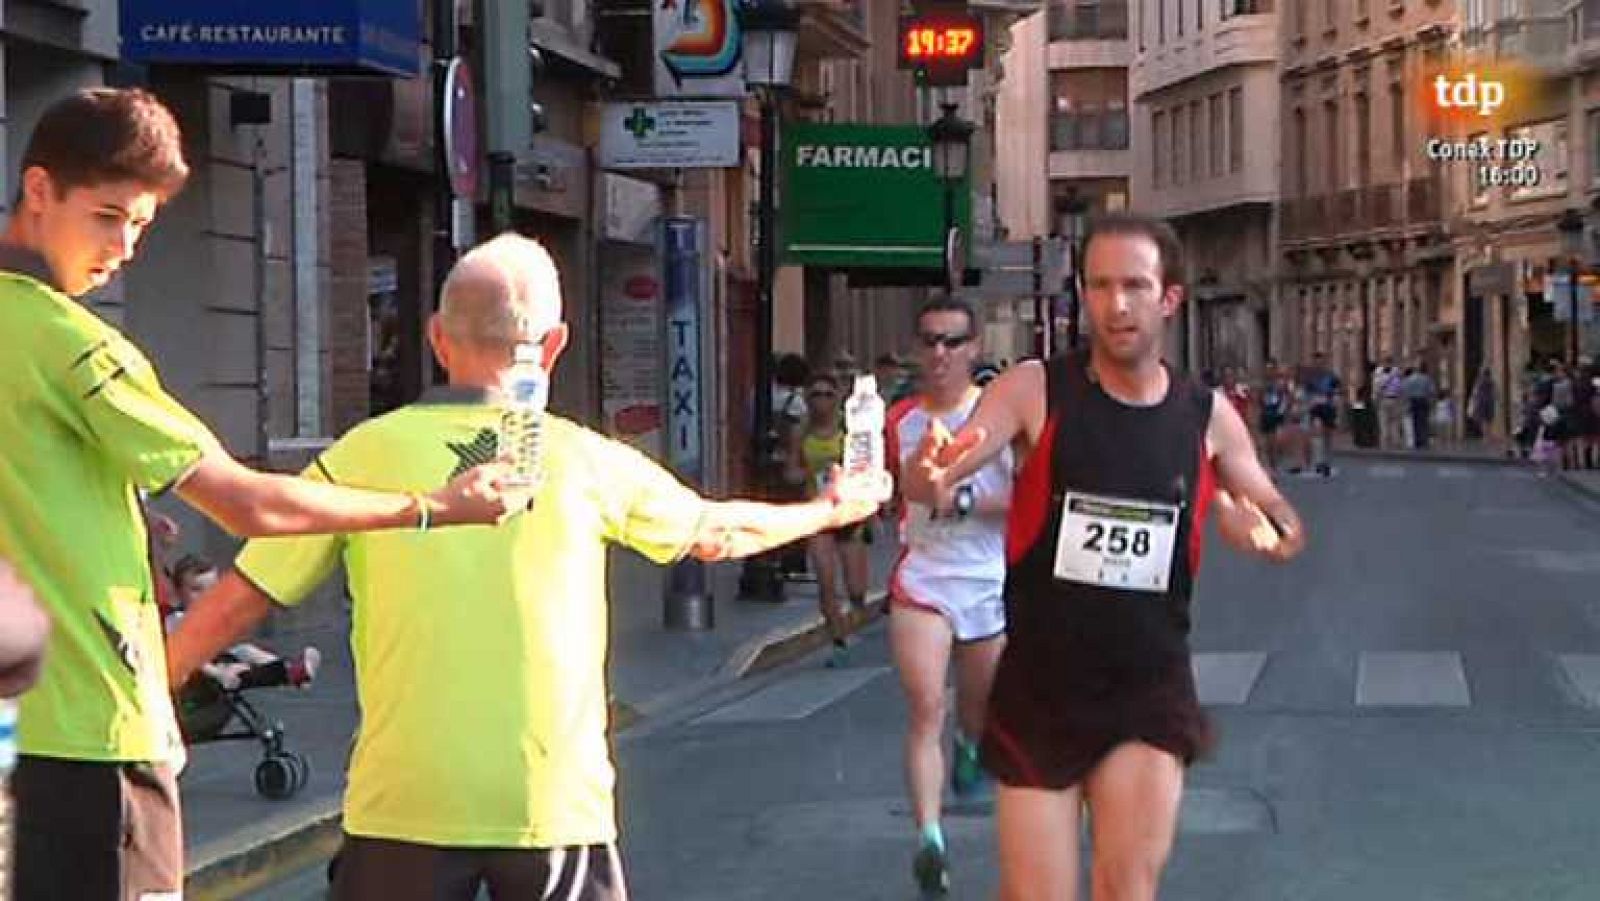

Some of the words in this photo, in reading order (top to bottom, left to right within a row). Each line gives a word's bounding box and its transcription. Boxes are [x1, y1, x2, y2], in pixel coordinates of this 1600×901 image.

[907, 28, 975, 55] 19:37
[796, 144, 933, 169] FARMACI
[672, 319, 694, 449] TAXI
[1081, 522, 1151, 557] 258
